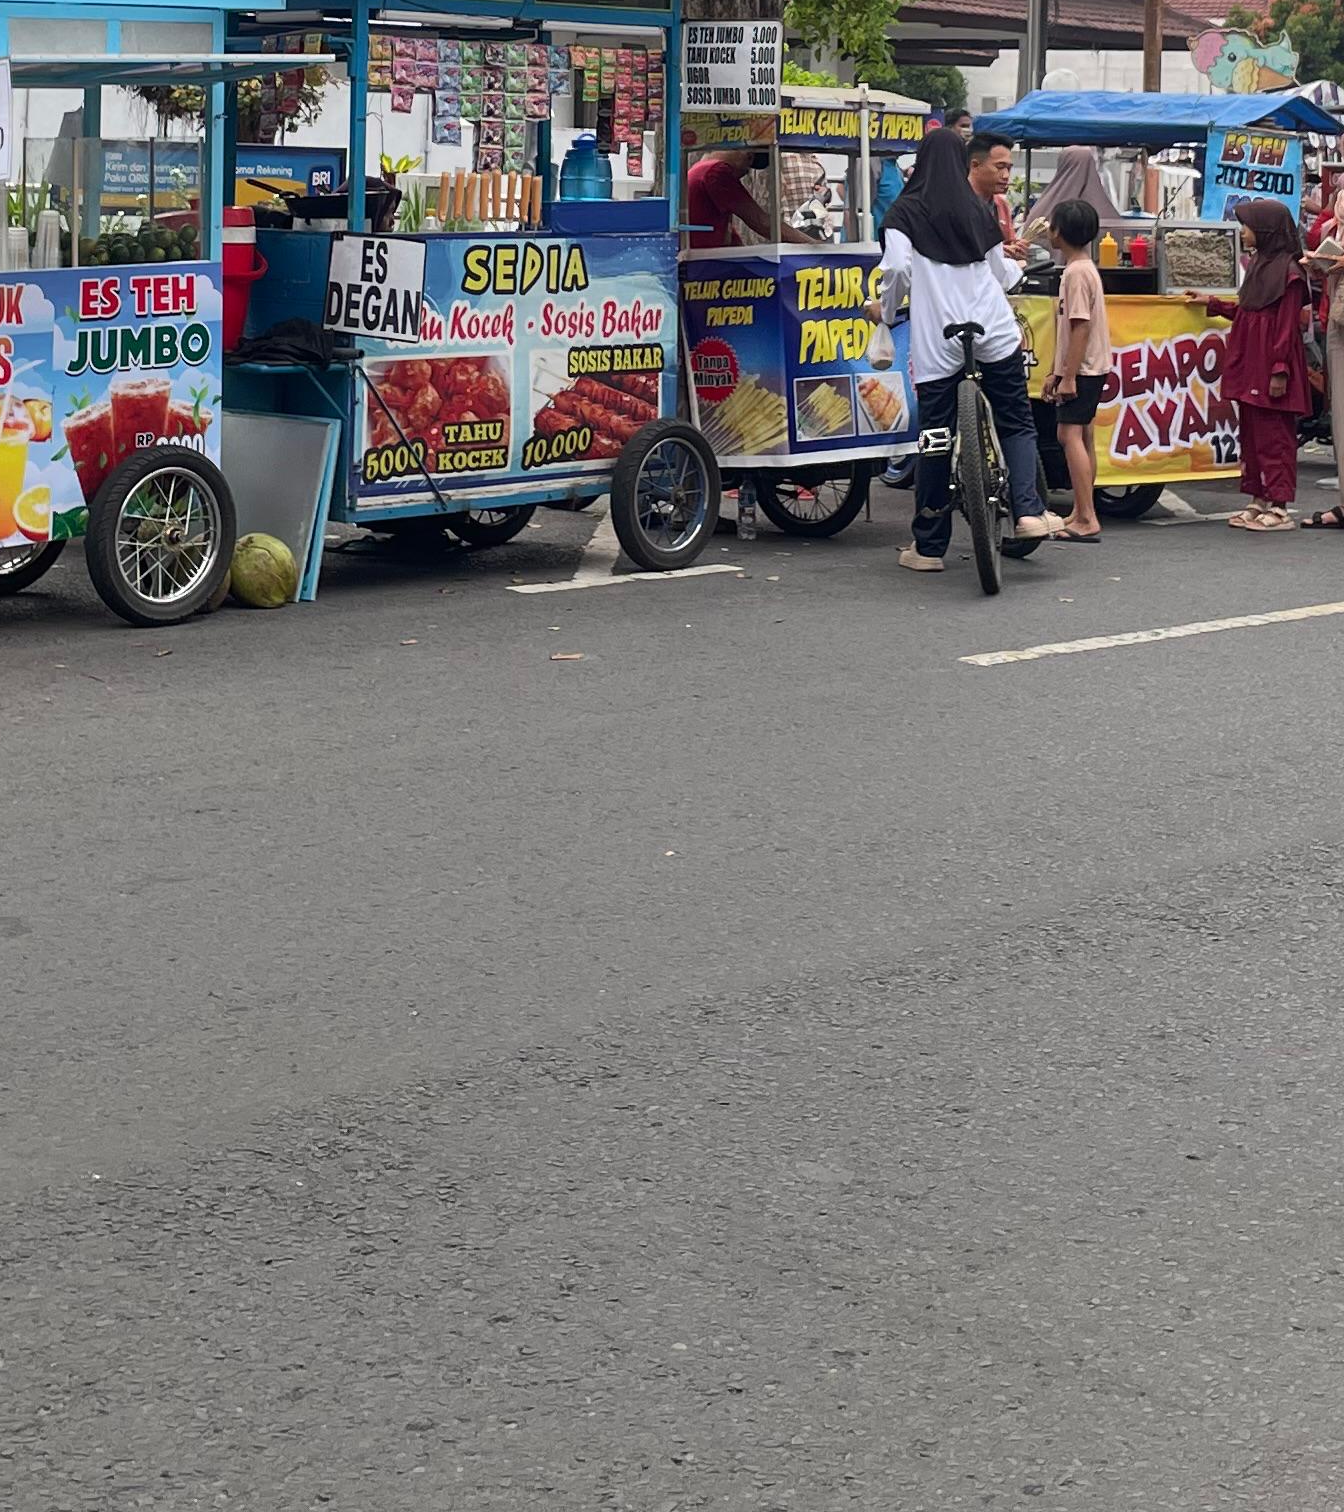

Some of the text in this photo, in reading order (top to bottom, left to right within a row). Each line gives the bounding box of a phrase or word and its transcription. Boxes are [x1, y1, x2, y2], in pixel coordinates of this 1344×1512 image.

[688, 27, 698, 44] ES
[716, 27, 744, 44] JUMBO
[687, 47, 708, 64] TAHU
[709, 47, 736, 64] KOCEK
[687, 87, 712, 105] SOSIS
[714, 88, 741, 105] JUMBO
[779, 108, 817, 135] TELUR
[817, 111, 862, 138] GULUN
[881, 114, 924, 141] PAPEDA
[1220, 133, 1288, 166] ES TEH
[256, 164, 293, 178] Rekening
[312, 171, 331, 186] BRI
[361, 241, 389, 284] ES
[462, 243, 589, 295] SEDIA
[81, 274, 197, 318] ES TEH
[683, 277, 776, 301] TELUR GULUNG
[794, 265, 865, 311] TELUR
[326, 282, 421, 337] DEGAN
[541, 300, 595, 340] Sosis
[706, 305, 754, 326] PAPEDA
[66, 323, 211, 374] JUMBO
[799, 318, 876, 365] PAPED
[569, 346, 663, 375] SOSIS BAKAR
[697, 354, 730, 370] Tanpa
[694, 372, 732, 388] Minyak
[136, 433, 154, 447] RP
[444, 420, 504, 444] TAHU
[365, 442, 426, 483] 5000
[437, 448, 506, 473] KOCEK
[523, 428, 592, 469] 10.000
